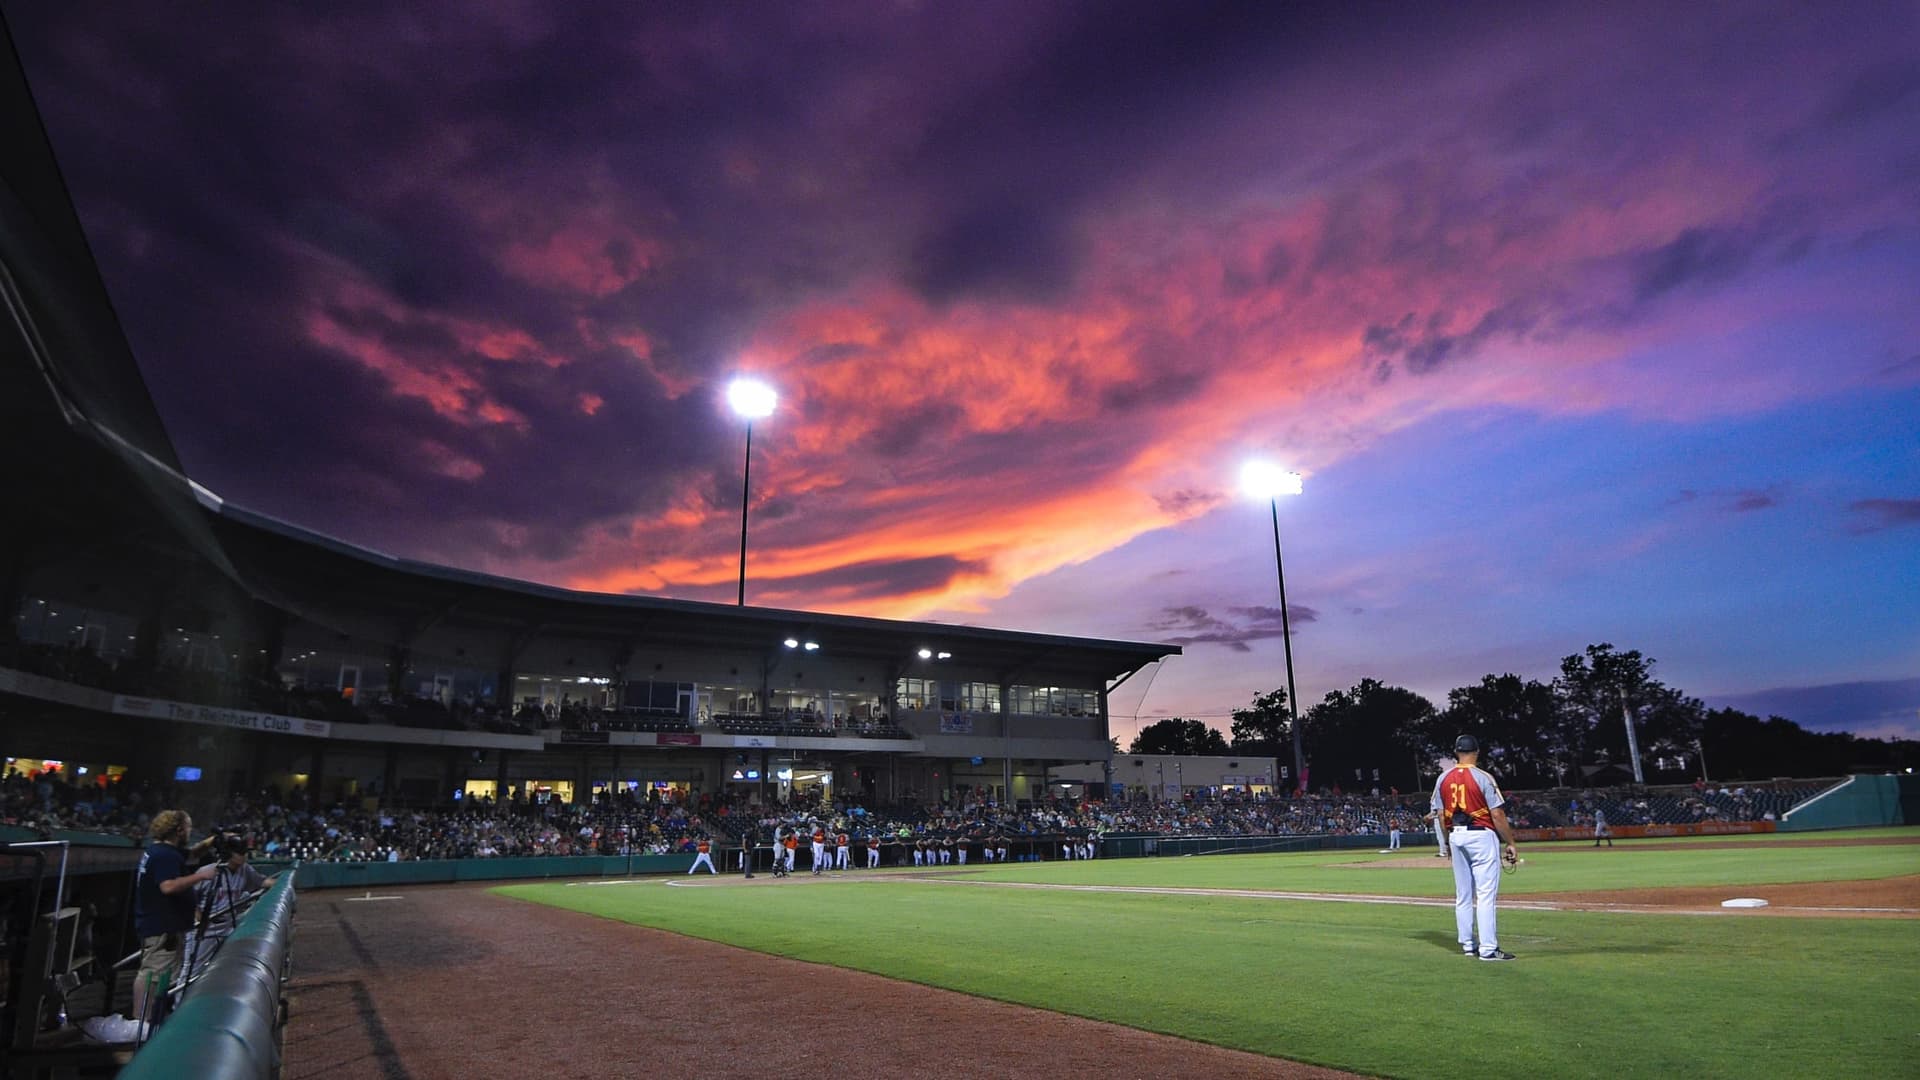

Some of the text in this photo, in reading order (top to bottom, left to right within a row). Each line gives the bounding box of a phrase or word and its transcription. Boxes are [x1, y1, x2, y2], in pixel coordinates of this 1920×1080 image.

[168, 703, 193, 719] The
[263, 715, 291, 730] Club
[1450, 783, 1467, 810] 31
